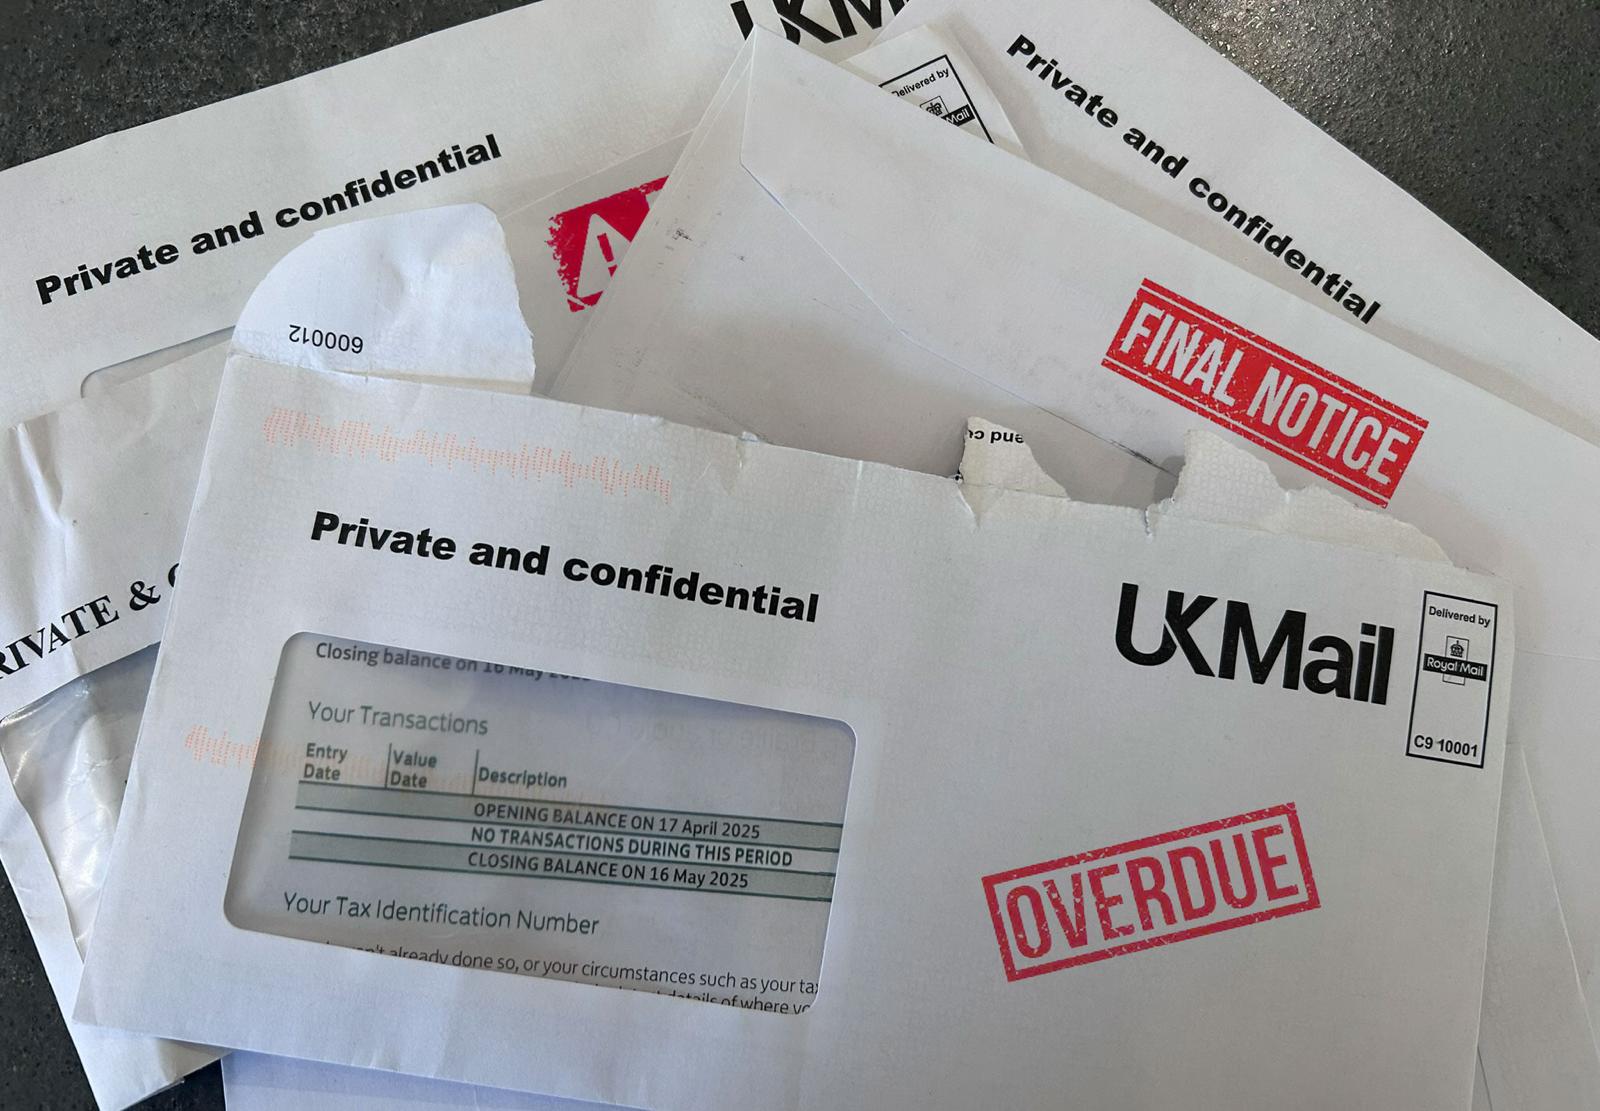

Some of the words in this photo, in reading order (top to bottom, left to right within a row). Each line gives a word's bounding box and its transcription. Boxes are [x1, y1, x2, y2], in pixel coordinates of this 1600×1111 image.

[936, 68, 949, 79] by
[1006, 34, 1118, 128] Private
[1122, 127, 1188, 178] and
[1188, 176, 1381, 324] confidential
[36, 243, 179, 304] Private
[192, 211, 263, 254] and
[276, 134, 501, 227] confidential
[289, 324, 364, 354] 600012
[1120, 300, 1238, 406] FINAL
[1247, 365, 1409, 485] NOTICE
[310, 511, 456, 560] Private
[469, 543, 550, 575] and
[563, 558, 819, 622] confidential
[129, 580, 161, 611] &
[1428, 606, 1476, 624] Delivered
[1478, 615, 1491, 628] by
[315, 643, 379, 666] Closing
[383, 650, 451, 671] balance
[456, 658, 478, 672] on
[1427, 657, 1457, 672] Royal
[1459, 663, 1484, 677] Mail
[308, 701, 354, 723] Your
[360, 706, 488, 735] Transactions
[306, 743, 348, 763] Entry
[393, 750, 437, 769] Value
[1414, 735, 1434, 749] C9
[1437, 739, 1478, 757] 10001
[303, 763, 341, 781] Date
[389, 771, 428, 789] Date
[478, 767, 568, 789] Description
[474, 803, 549, 823] OPENING
[552, 808, 628, 829] BALANCE
[631, 815, 655, 832] ON
[658, 818, 679, 833] 17
[682, 820, 718, 838] April
[721, 822, 761, 839] 2025
[471, 827, 496, 843] NO
[500, 829, 624, 854] TRANSACTIONS
[628, 839, 693, 859] DURING
[695, 844, 731, 861] THIS
[735, 849, 793, 867] PERIOD
[468, 852, 539, 871] CLOSING
[543, 858, 618, 878] BALANCE
[621, 864, 646, 881] ON
[649, 867, 669, 882] 16
[673, 868, 706, 888] May
[709, 872, 749, 889] 2025
[1006, 823, 1300, 959] OVERDUE
[284, 891, 331, 915] Your
[336, 896, 371, 917] Tax
[376, 900, 511, 928] Identification
[517, 909, 600, 935] Number
[452, 951, 493, 969] done
[496, 958, 519, 973] so,
[523, 960, 540, 972] or
[542, 959, 578, 977] your
[582, 960, 695, 985] circumstances
[699, 971, 736, 989] such
[740, 977, 758, 990] as
[760, 978, 797, 999] your
[740, 996, 789, 1014] where
